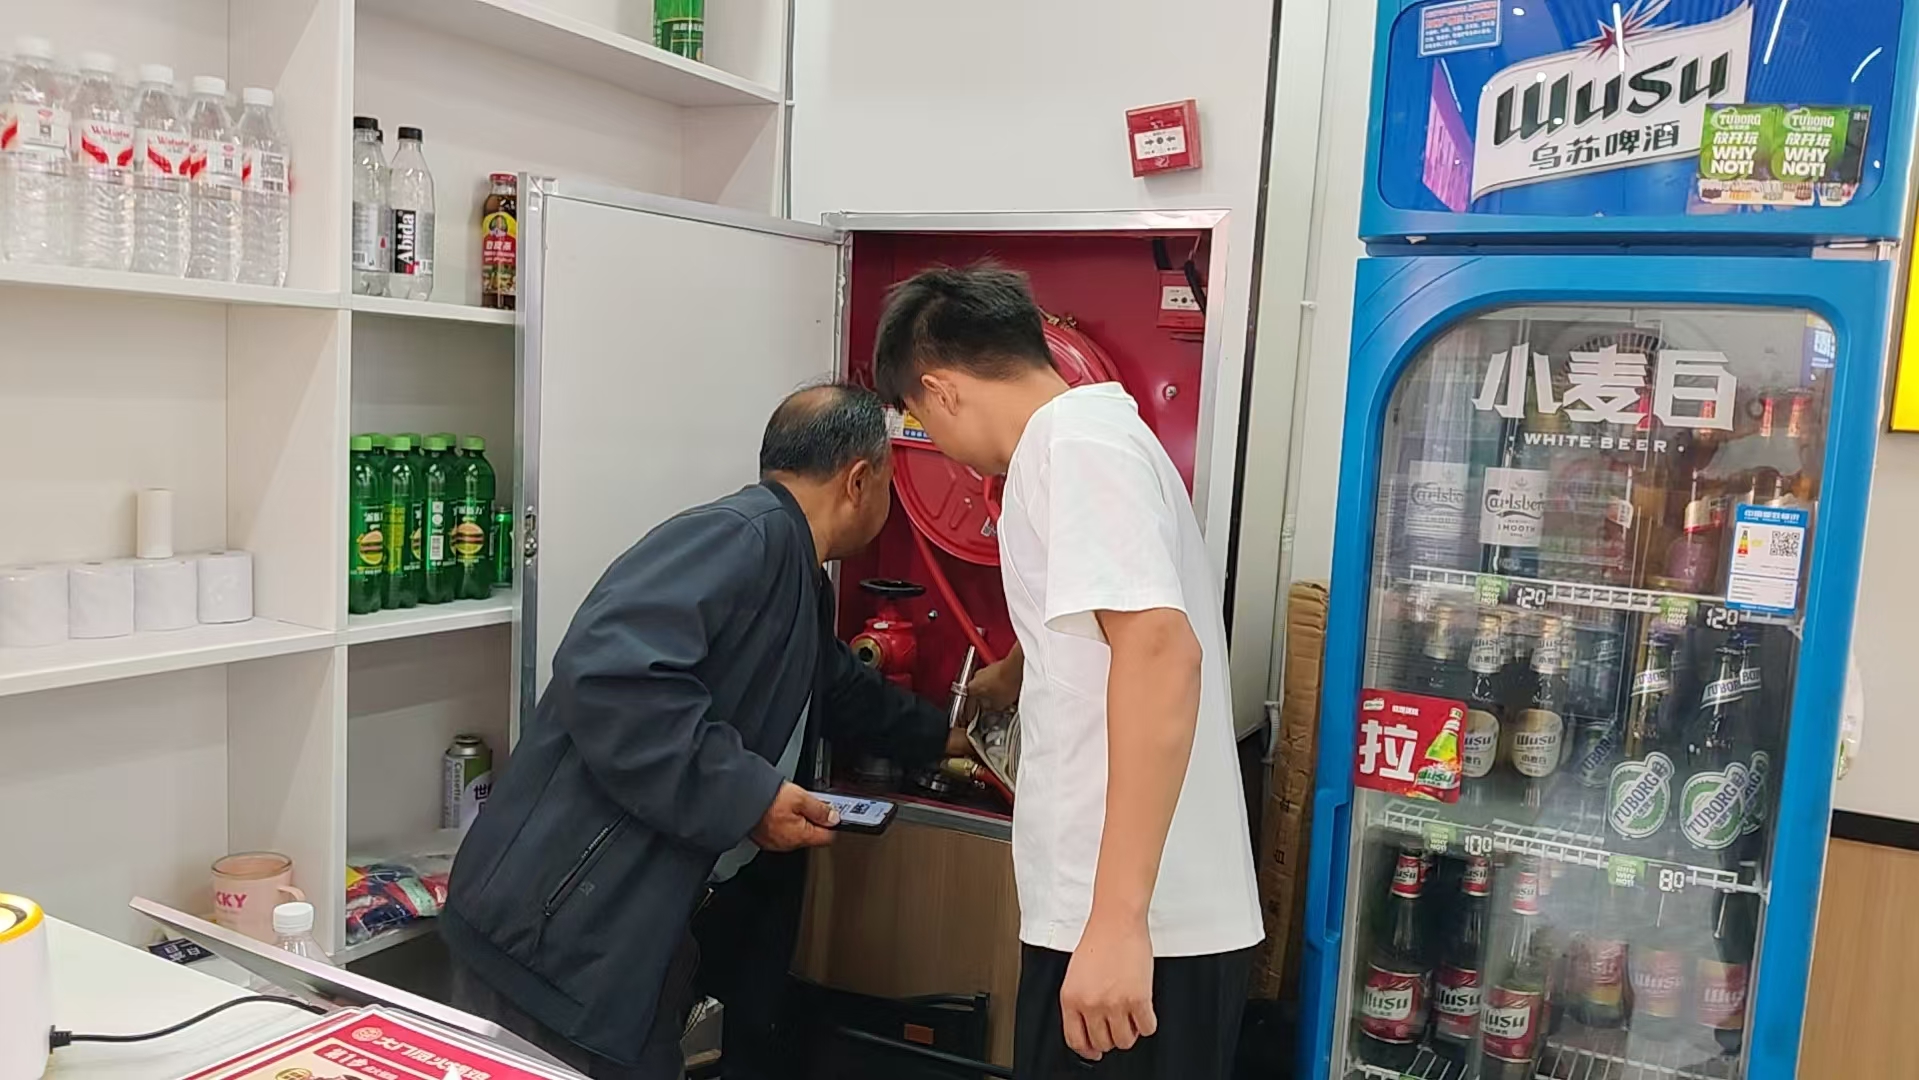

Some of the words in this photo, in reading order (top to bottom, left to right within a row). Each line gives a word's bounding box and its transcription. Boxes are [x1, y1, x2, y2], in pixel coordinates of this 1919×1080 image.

[1529, 120, 1680, 170] 乌苏啤酒
[1711, 160, 1755, 174] NOT!
[1712, 146, 1757, 160] WHY
[1782, 161, 1826, 176] NOT!
[1783, 147, 1830, 162] WHY
[397, 214, 415, 265] Abida
[1471, 342, 1738, 431] 小麦白
[1524, 432, 1593, 448] WHITE
[1600, 436, 1668, 453] BEER
[1359, 720, 1418, 782] 拉
[1614, 771, 1660, 825] TUBORG
[1686, 783, 1737, 835] TUBORG
